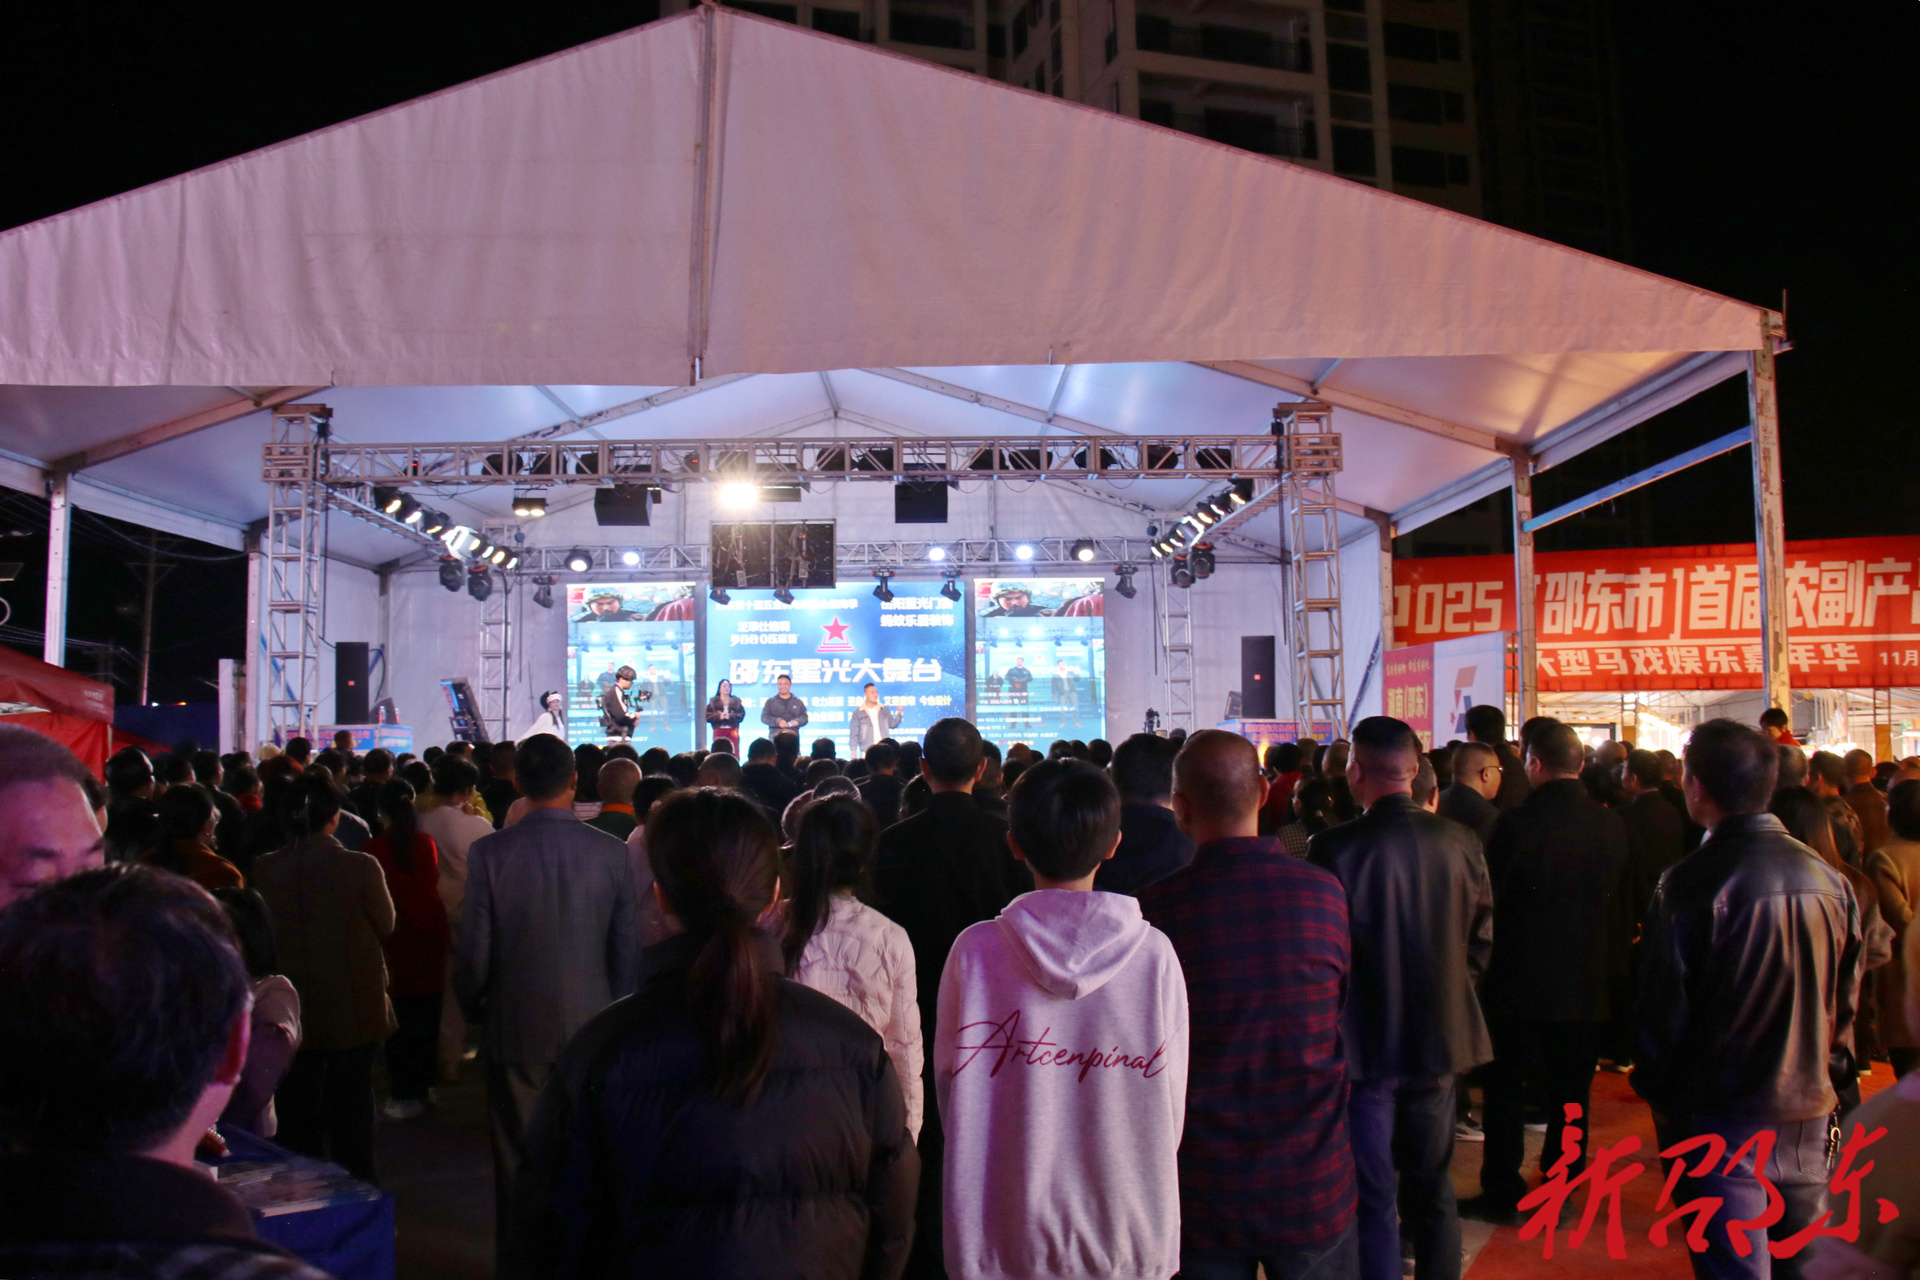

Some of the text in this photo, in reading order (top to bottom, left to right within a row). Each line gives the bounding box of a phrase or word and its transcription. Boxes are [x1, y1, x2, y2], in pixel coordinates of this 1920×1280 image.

[729, 658, 942, 684] 邵东星光大舞台
